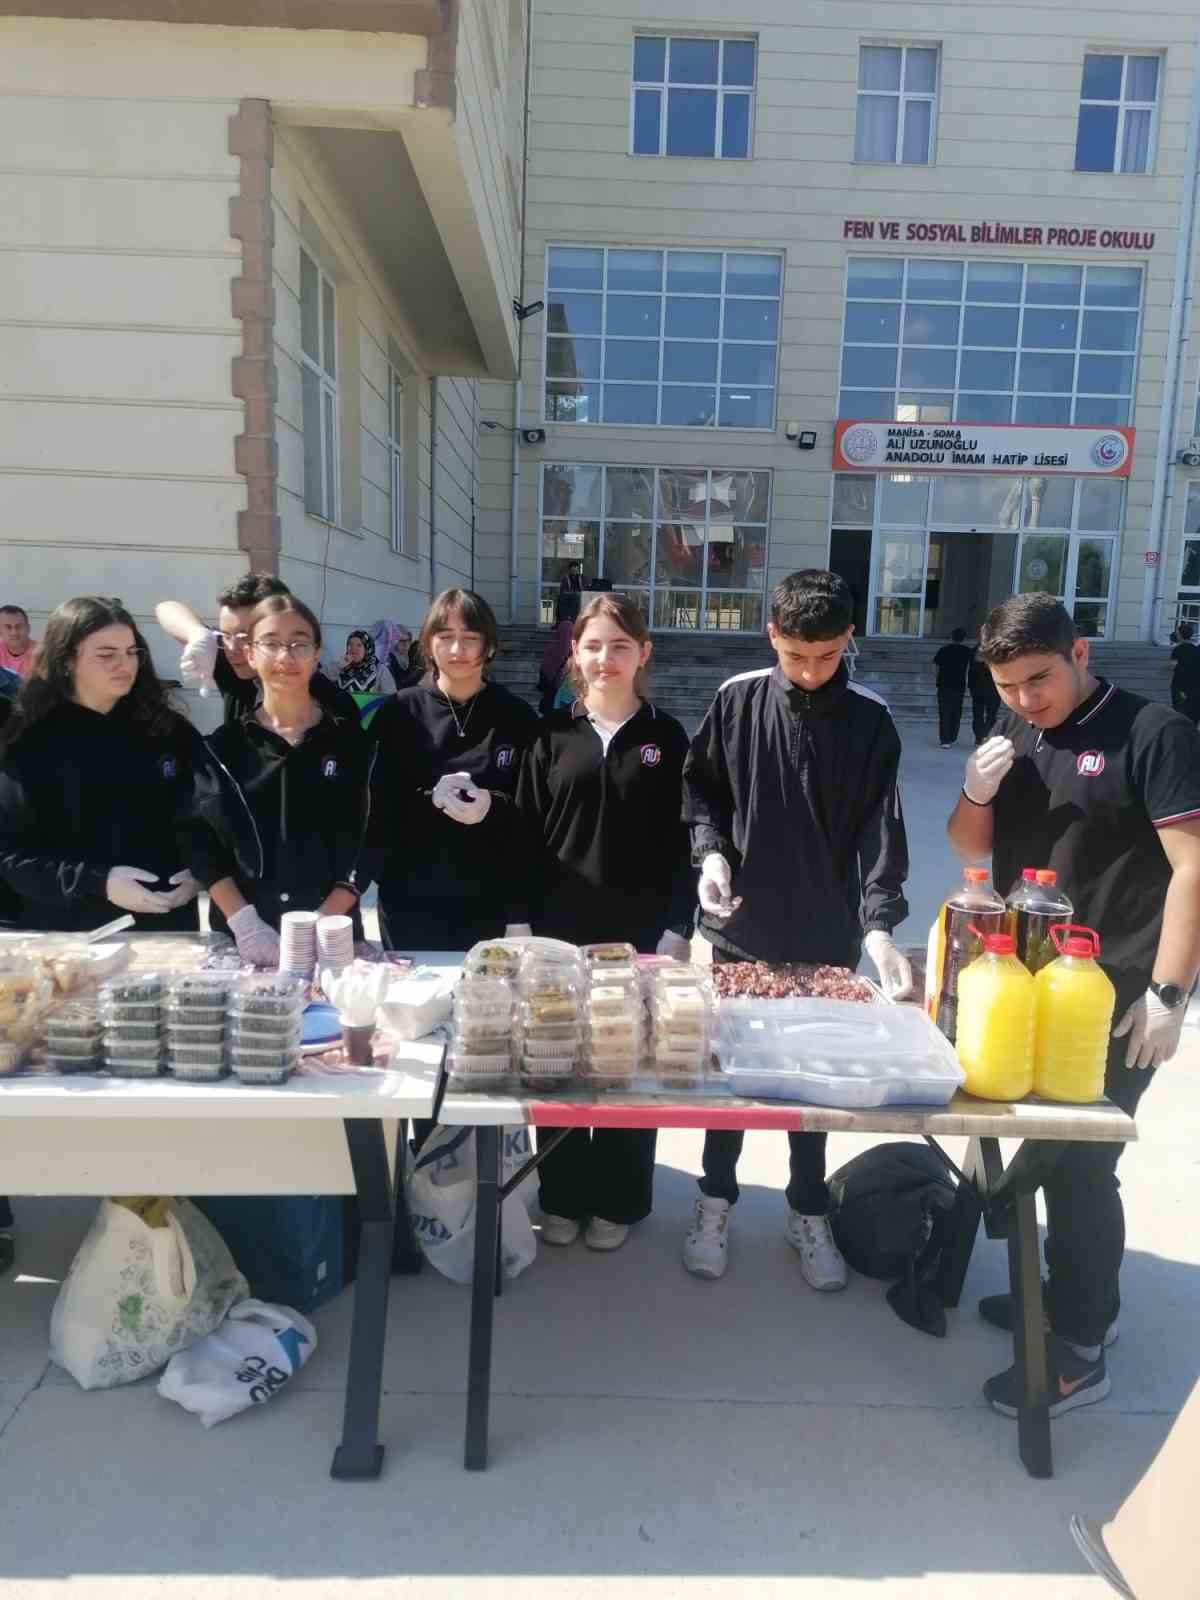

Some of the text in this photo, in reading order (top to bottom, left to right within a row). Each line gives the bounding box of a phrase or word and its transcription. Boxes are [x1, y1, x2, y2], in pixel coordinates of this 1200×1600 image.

[843, 220, 1155, 250] FEN VE SOSYAL BİLİMLER PROJE OKULU
[887, 427, 924, 437] MANİSA
[933, 429, 961, 439] SOMA
[886, 437, 978, 451] ALİ UZUNOĞLU
[886, 451, 1069, 466] ANADOLU İMAM HATİP LİSESİ
